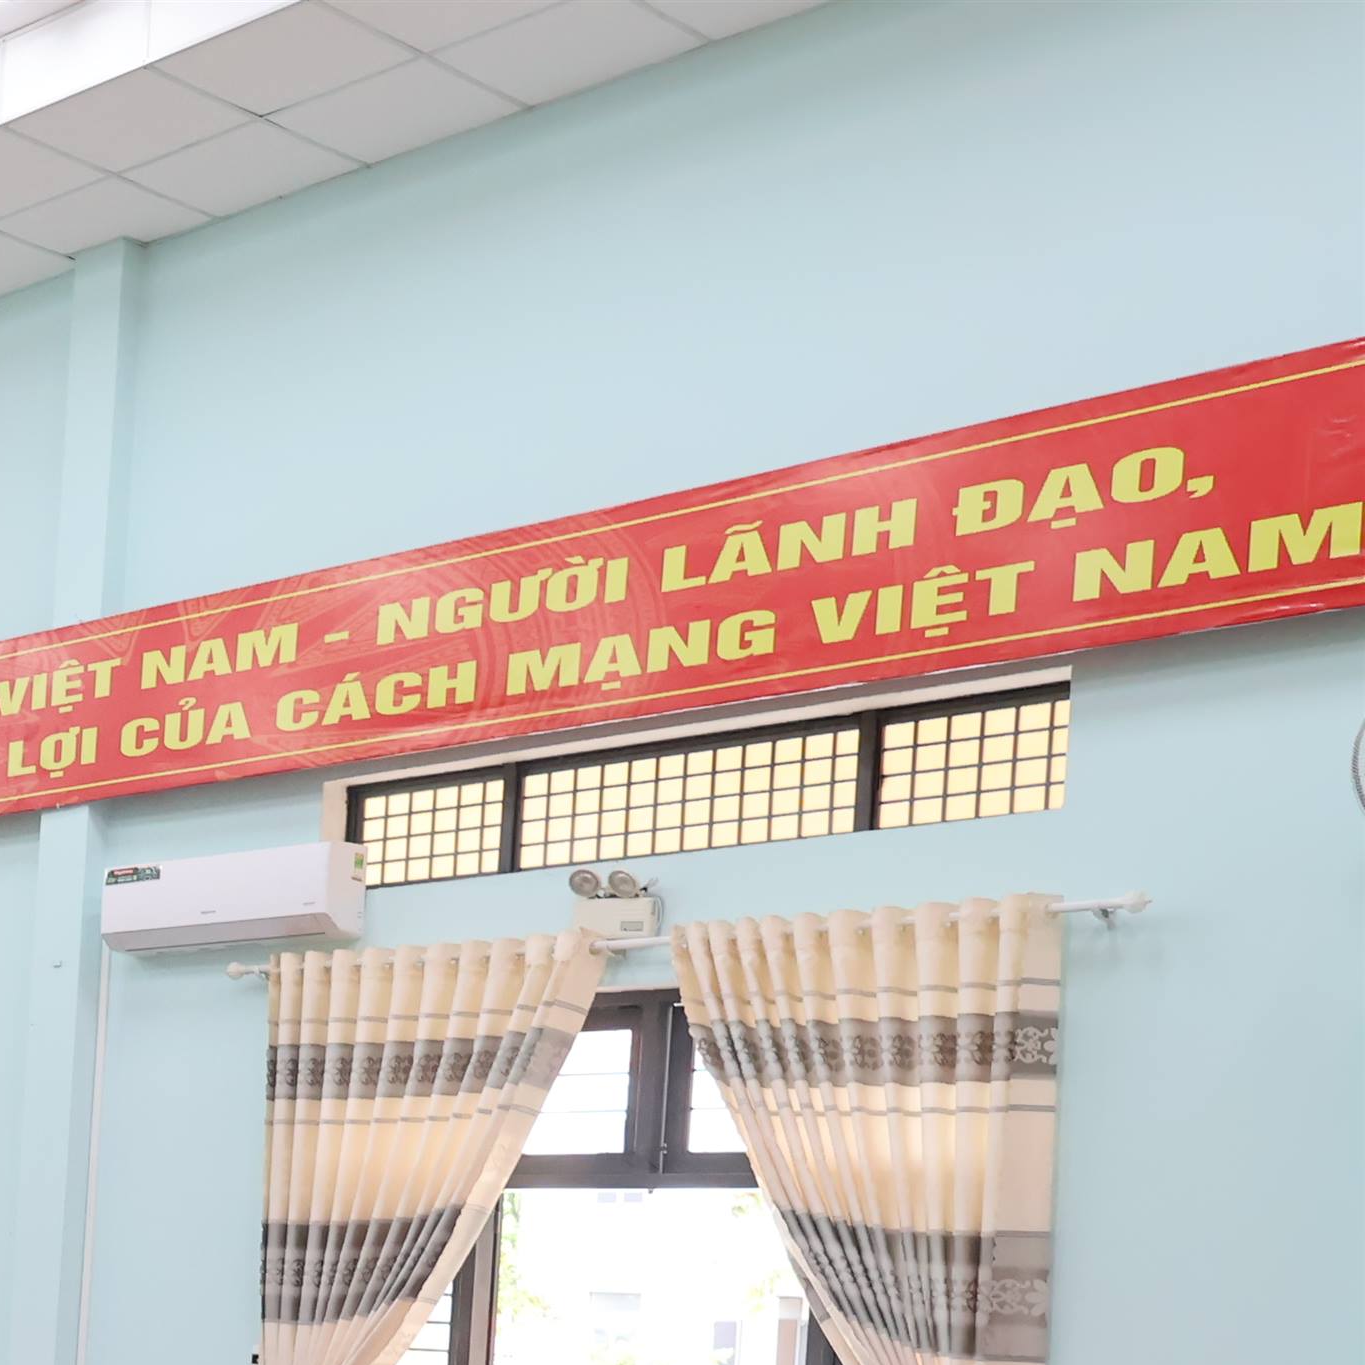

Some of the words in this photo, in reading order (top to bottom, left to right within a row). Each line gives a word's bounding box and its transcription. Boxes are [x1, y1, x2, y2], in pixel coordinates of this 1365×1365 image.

[7, 725, 98, 778] LỢI
[119, 696, 252, 758] CỦA
[275, 659, 477, 732] CÁCH
[506, 608, 777, 696] MẠNG
[811, 560, 1035, 645] VIỆT
[1072, 501, 1364, 602] NAM
[140, 622, 299, 689] NAM
[376, 555, 629, 646] NGƯỜI
[661, 498, 918, 593] LÃNH
[952, 445, 1215, 537] ĐẠO,
